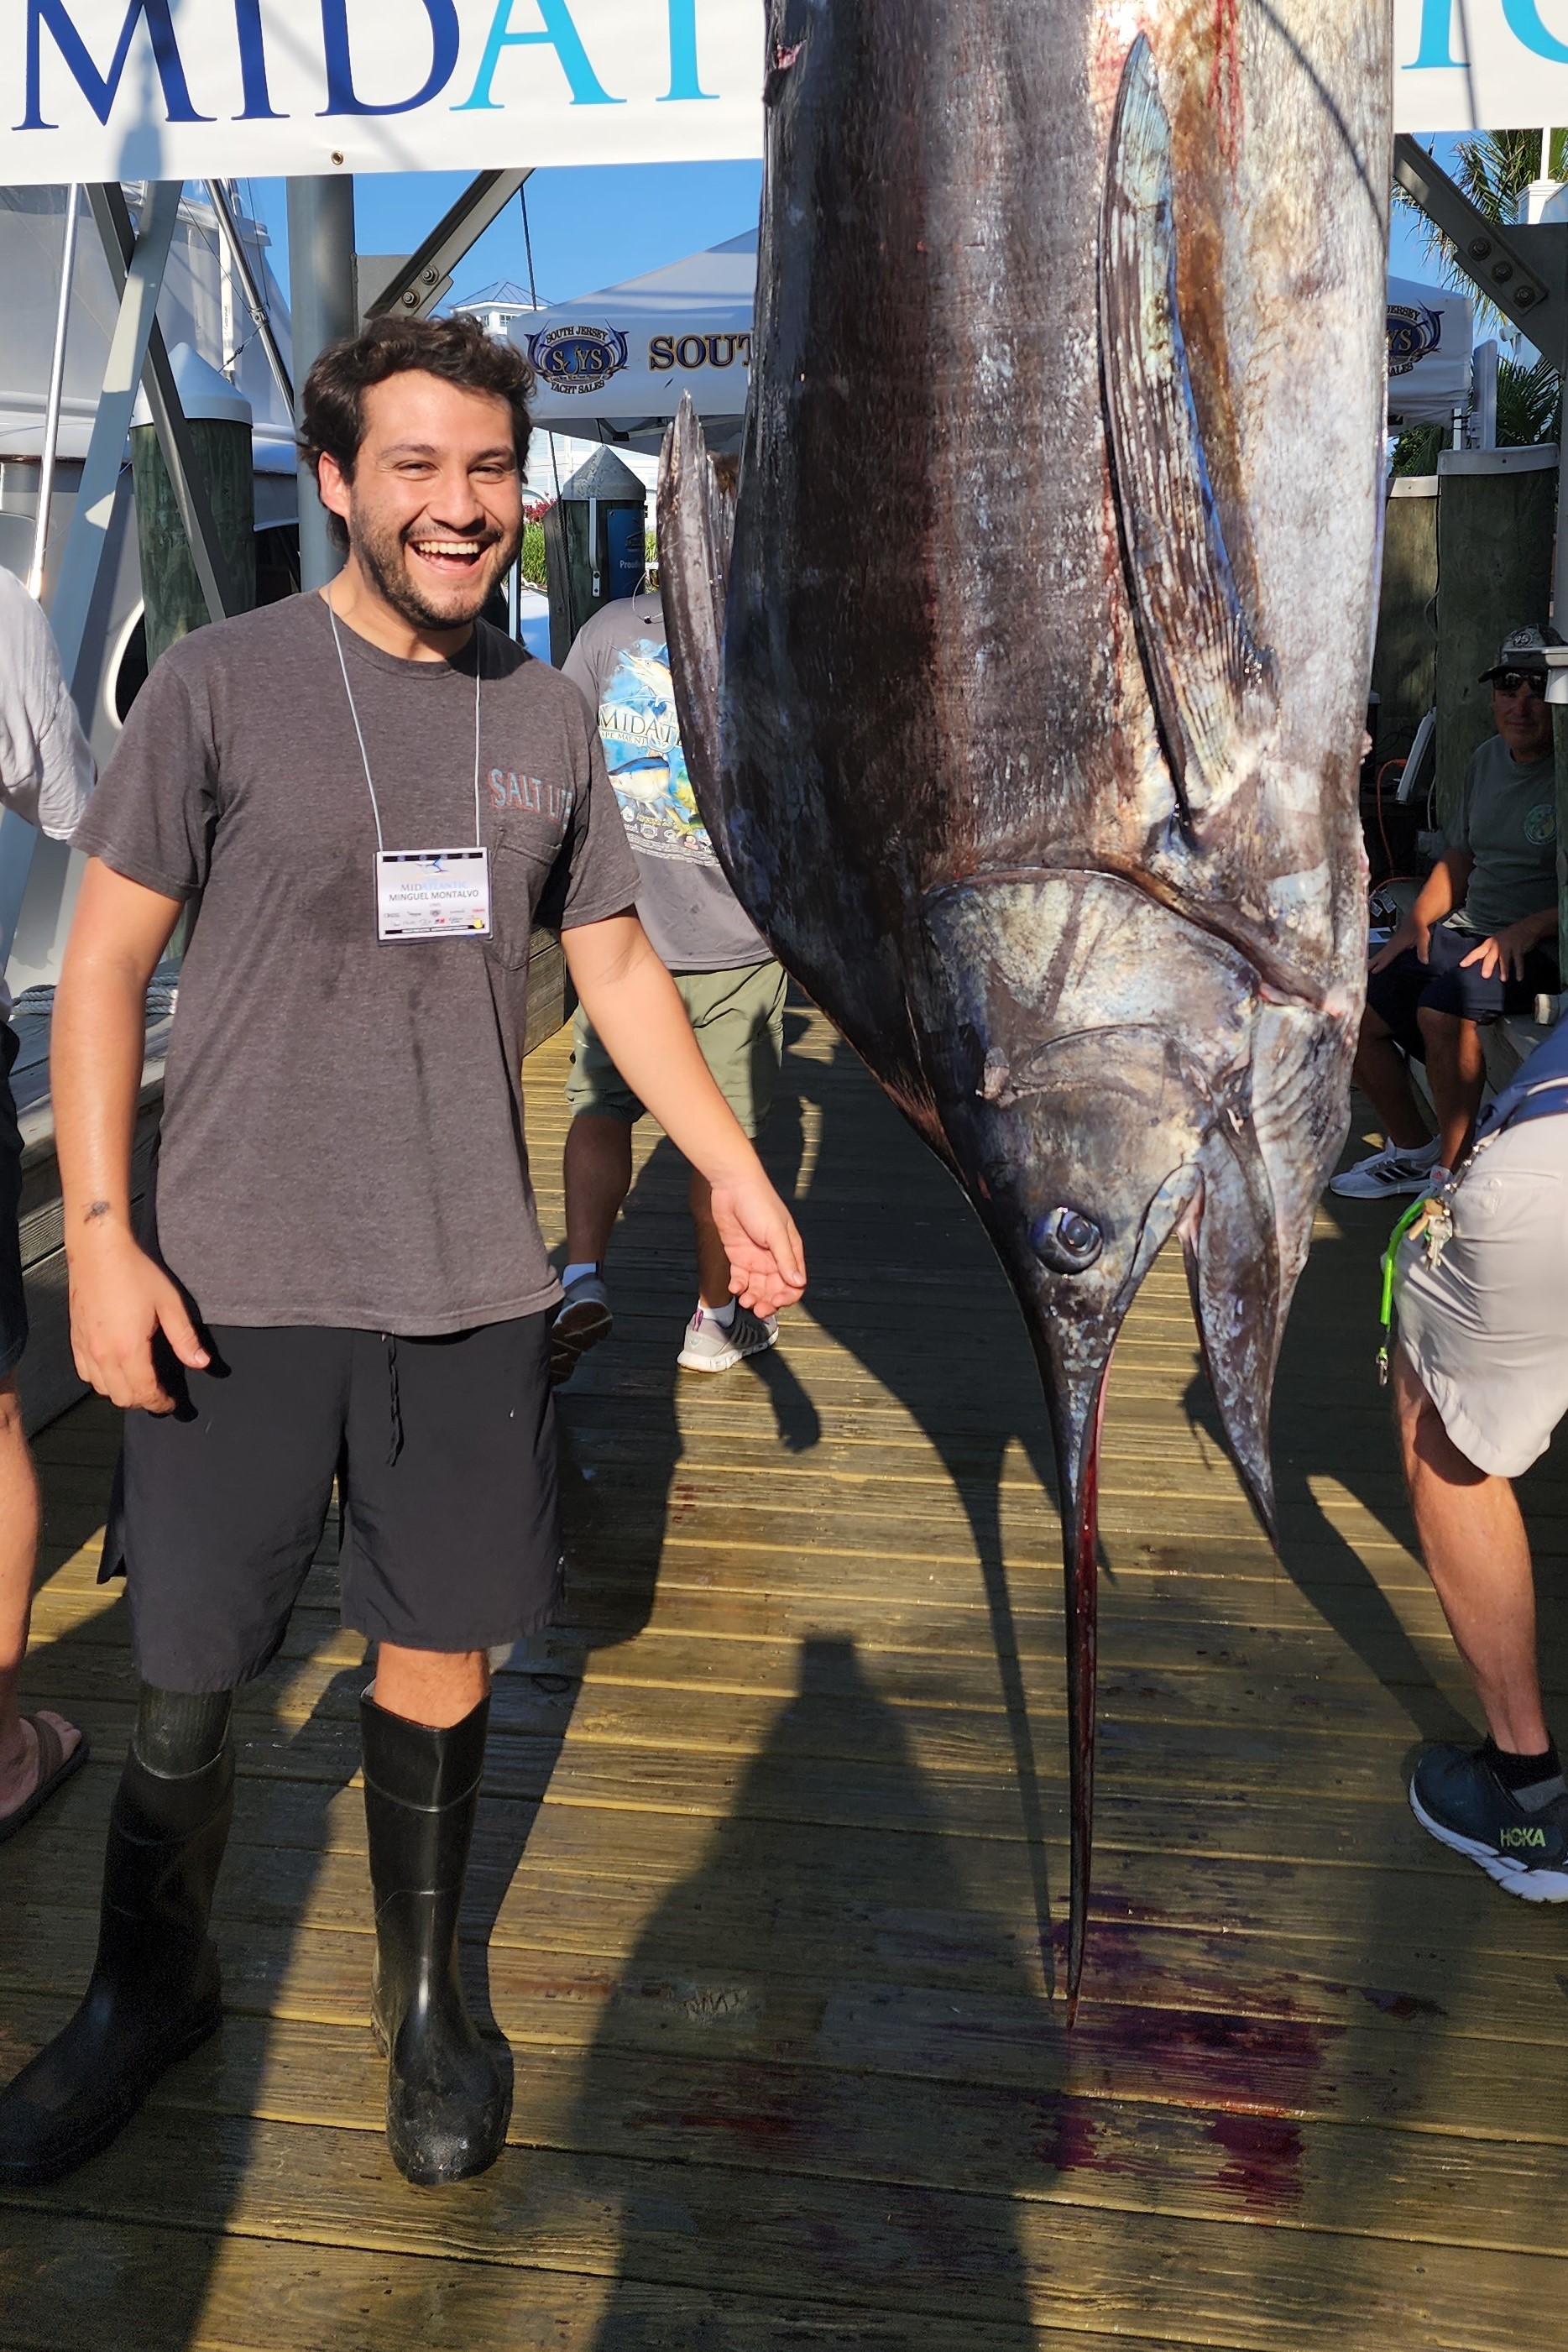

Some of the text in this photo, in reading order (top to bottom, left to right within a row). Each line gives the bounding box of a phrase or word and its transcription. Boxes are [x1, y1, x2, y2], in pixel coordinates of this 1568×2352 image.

[546, 326, 608, 343] SOUTH JERSEY
[1388, 362, 1414, 377] ALES
[551, 379, 605, 394] YACHT SALES
[488, 768, 541, 814] SALT
[431, 890, 479, 899] MONTALVO
[1499, 1827, 1546, 1847] HOKA
